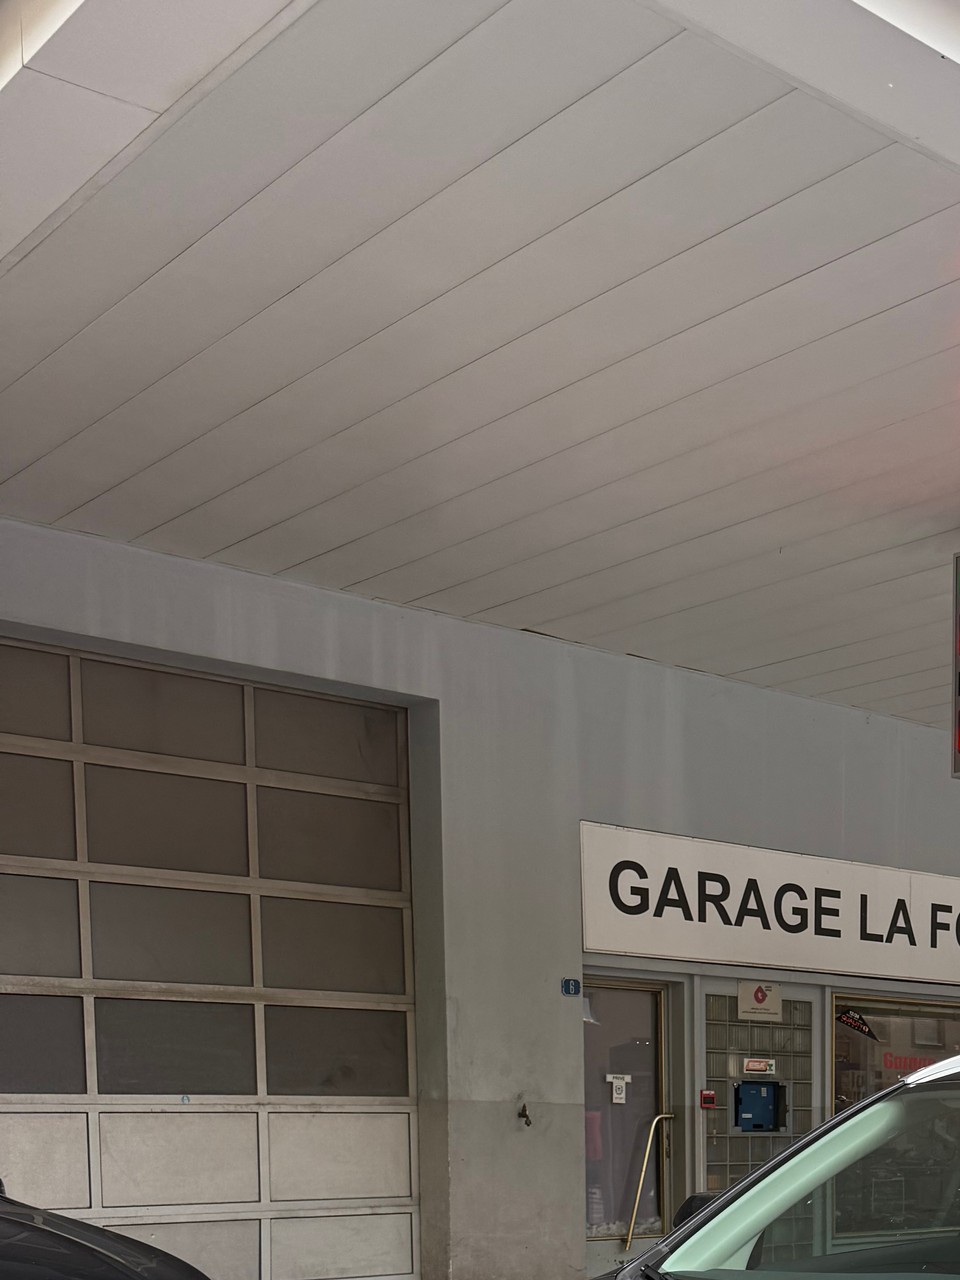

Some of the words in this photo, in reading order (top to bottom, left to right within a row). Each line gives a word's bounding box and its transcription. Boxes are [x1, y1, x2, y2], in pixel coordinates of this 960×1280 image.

[608, 859, 842, 938] GARAGE
[859, 893, 917, 946] LA
[569, 980, 575, 994] 6
